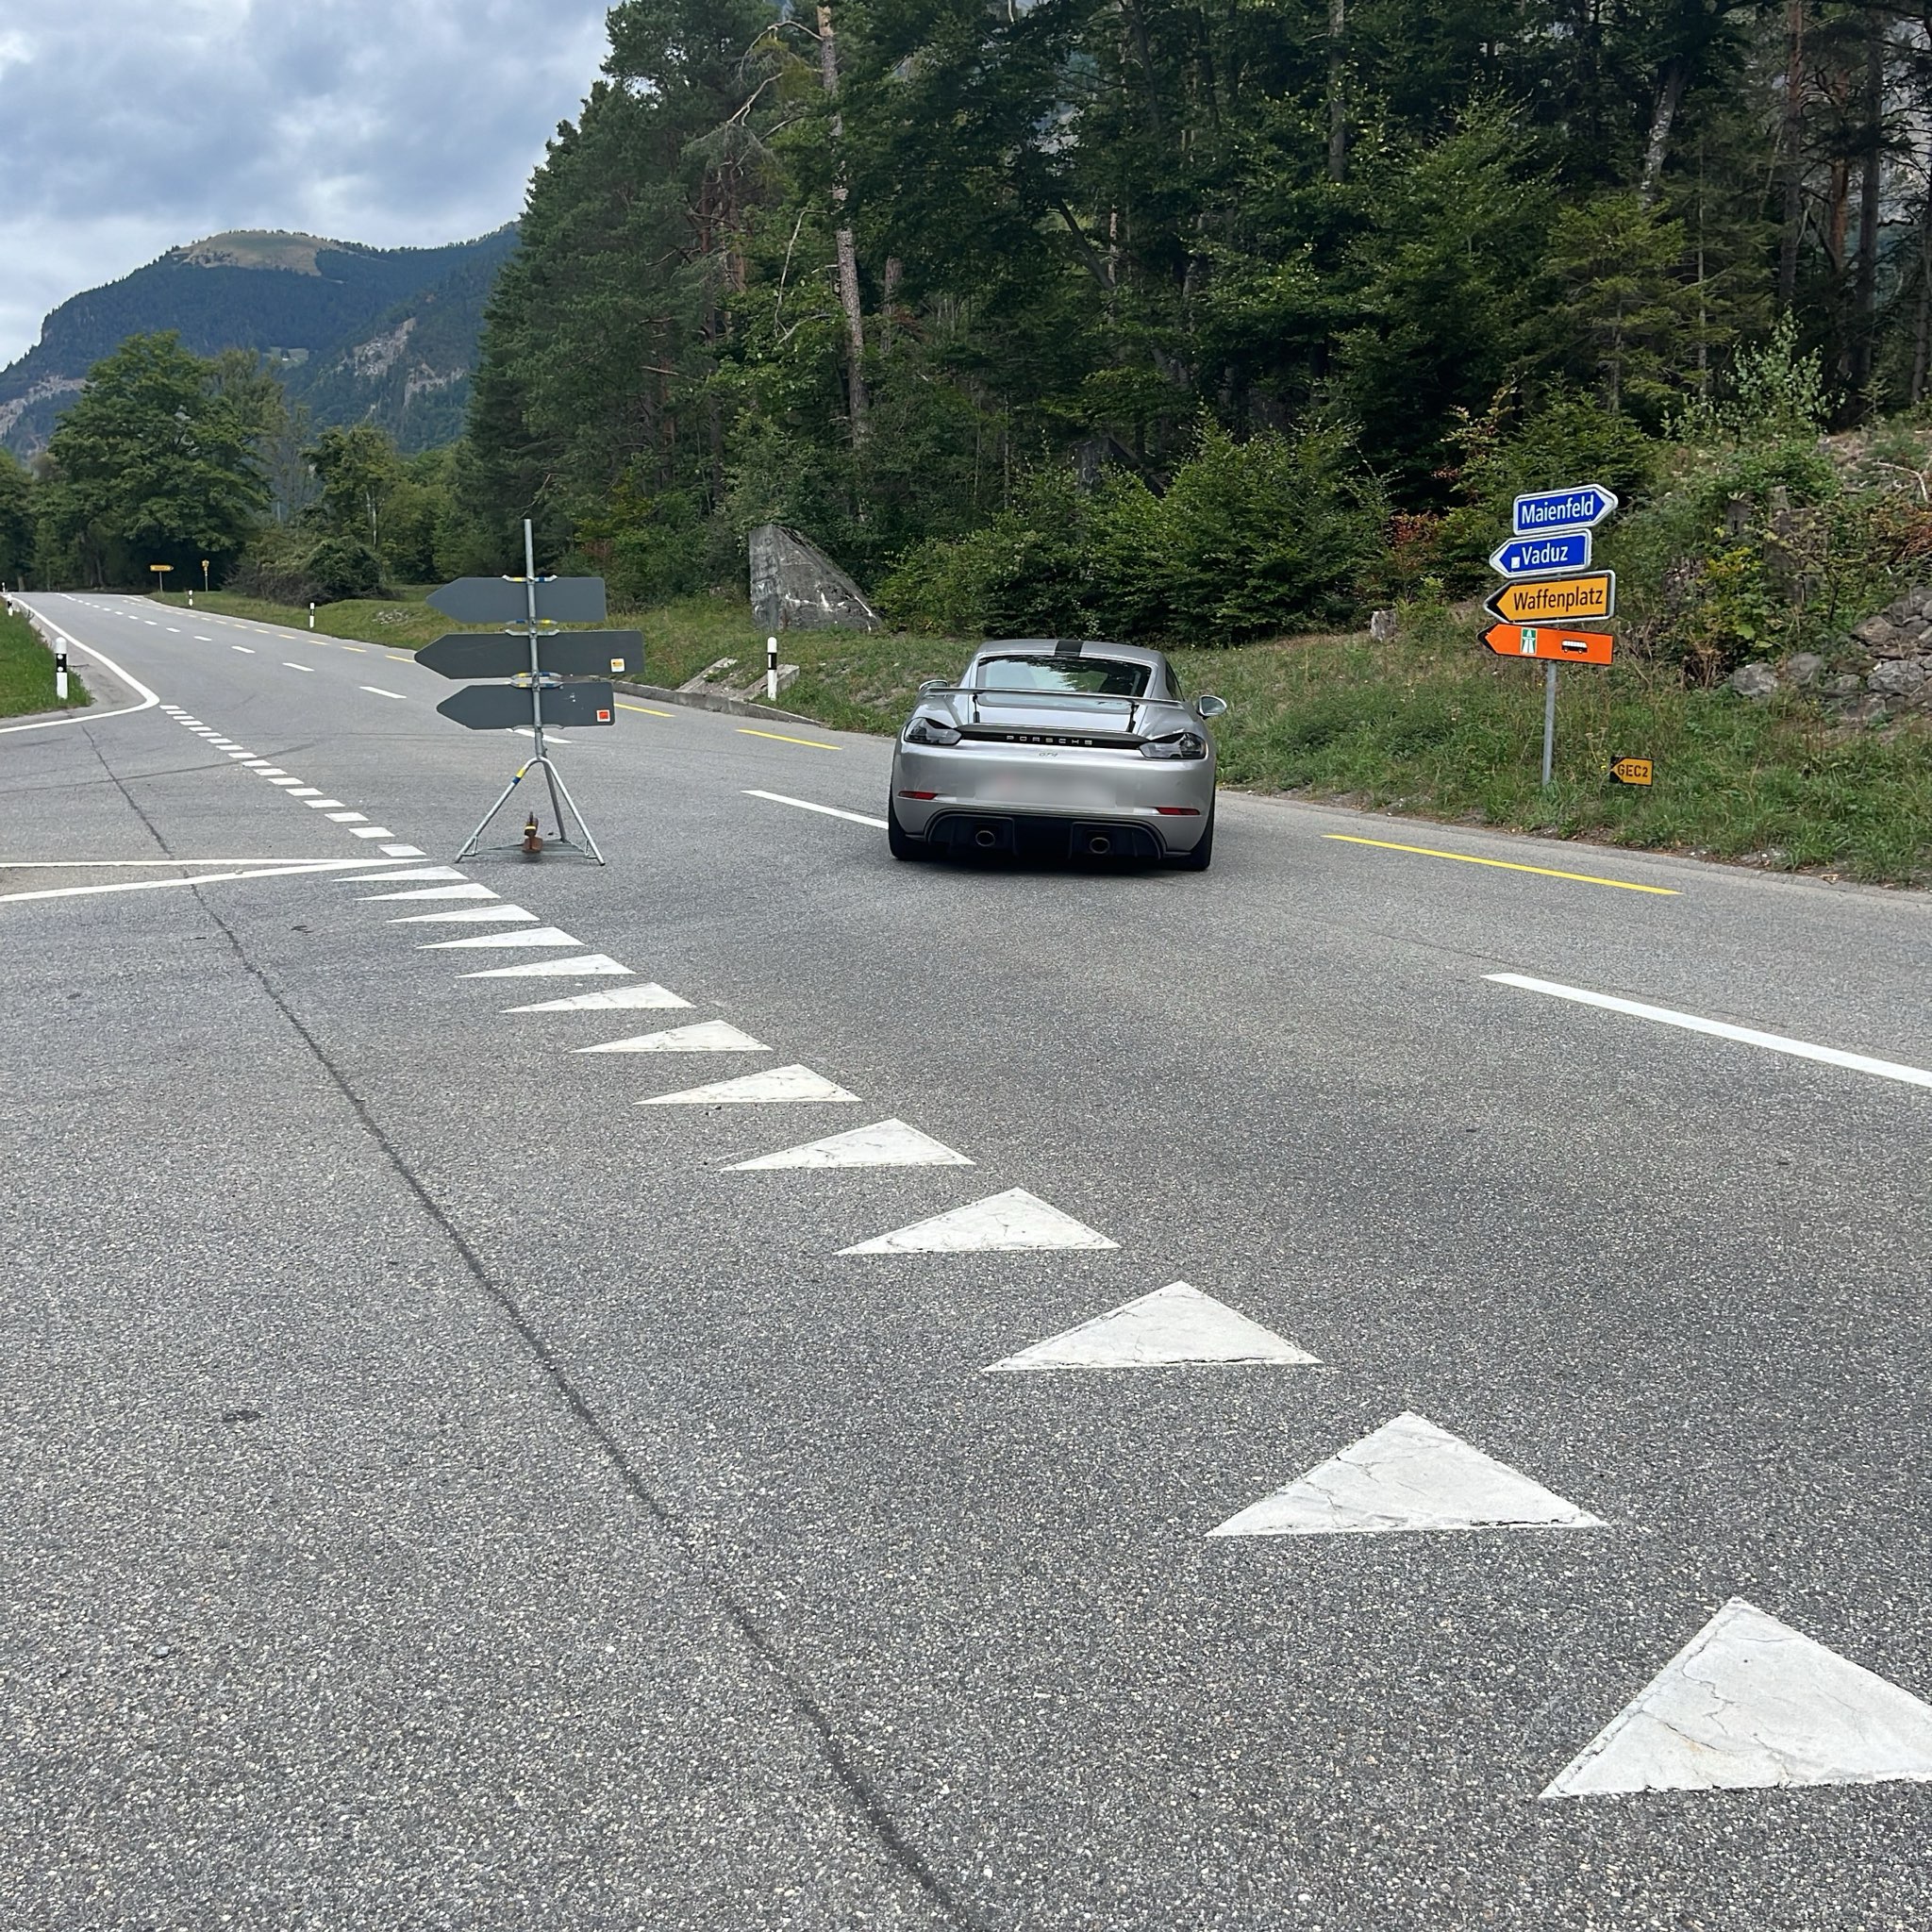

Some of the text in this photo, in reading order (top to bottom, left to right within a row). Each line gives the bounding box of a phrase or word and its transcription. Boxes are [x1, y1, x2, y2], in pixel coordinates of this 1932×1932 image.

[1521, 494, 1594, 525] Maienfeld
[1522, 542, 1569, 565] Vaduz
[1513, 586, 1604, 612] Waffenplatz
[1006, 735, 1092, 745] PORSCHE
[1617, 764, 1648, 777] GEC2
